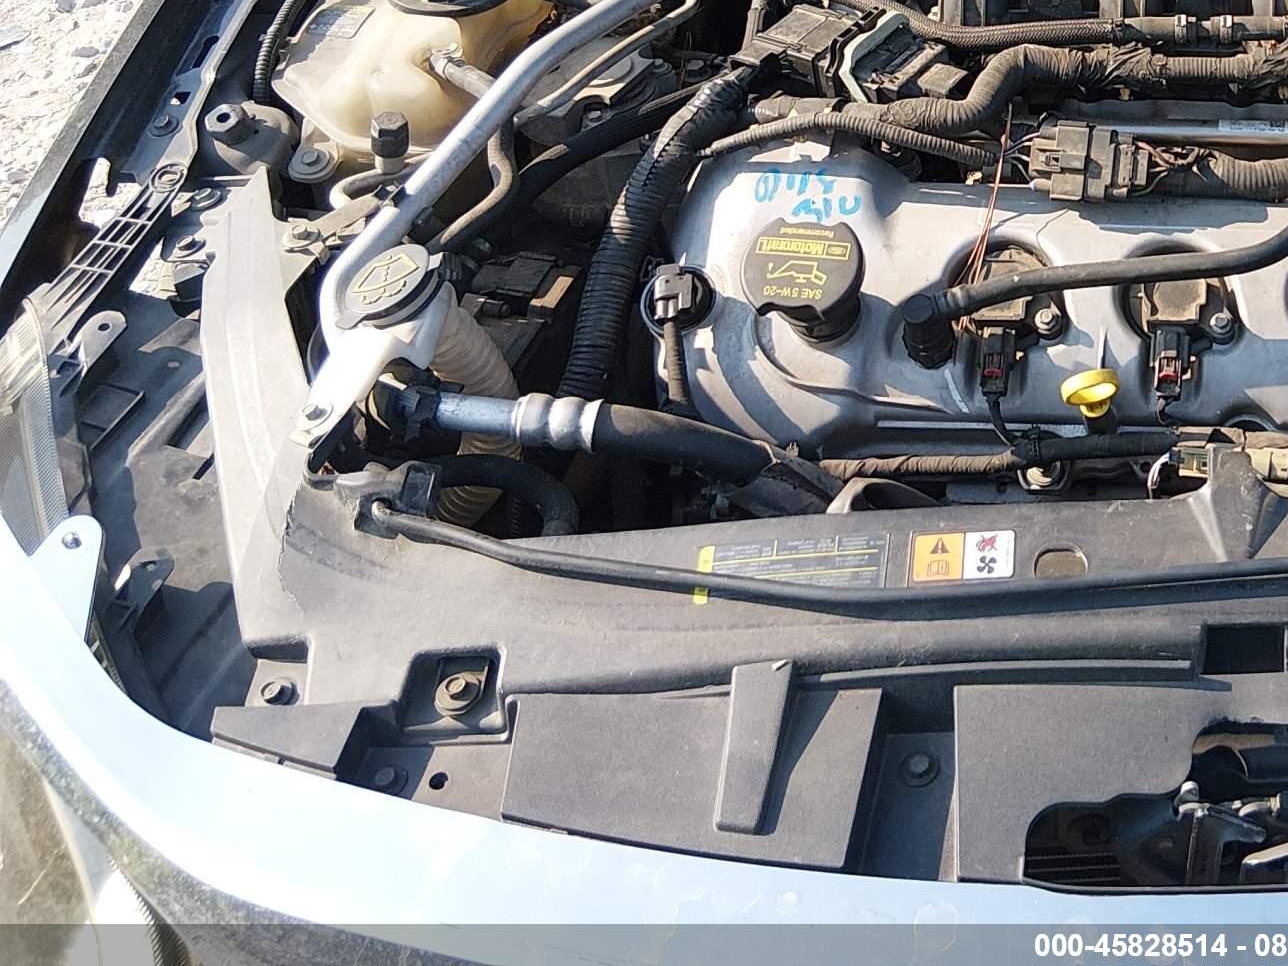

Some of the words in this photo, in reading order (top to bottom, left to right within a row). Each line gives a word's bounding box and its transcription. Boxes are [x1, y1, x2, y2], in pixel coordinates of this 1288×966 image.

[780, 227, 834, 238] Recommended
[761, 239, 825, 254] Motorcraft
[802, 287, 823, 299] SAE
